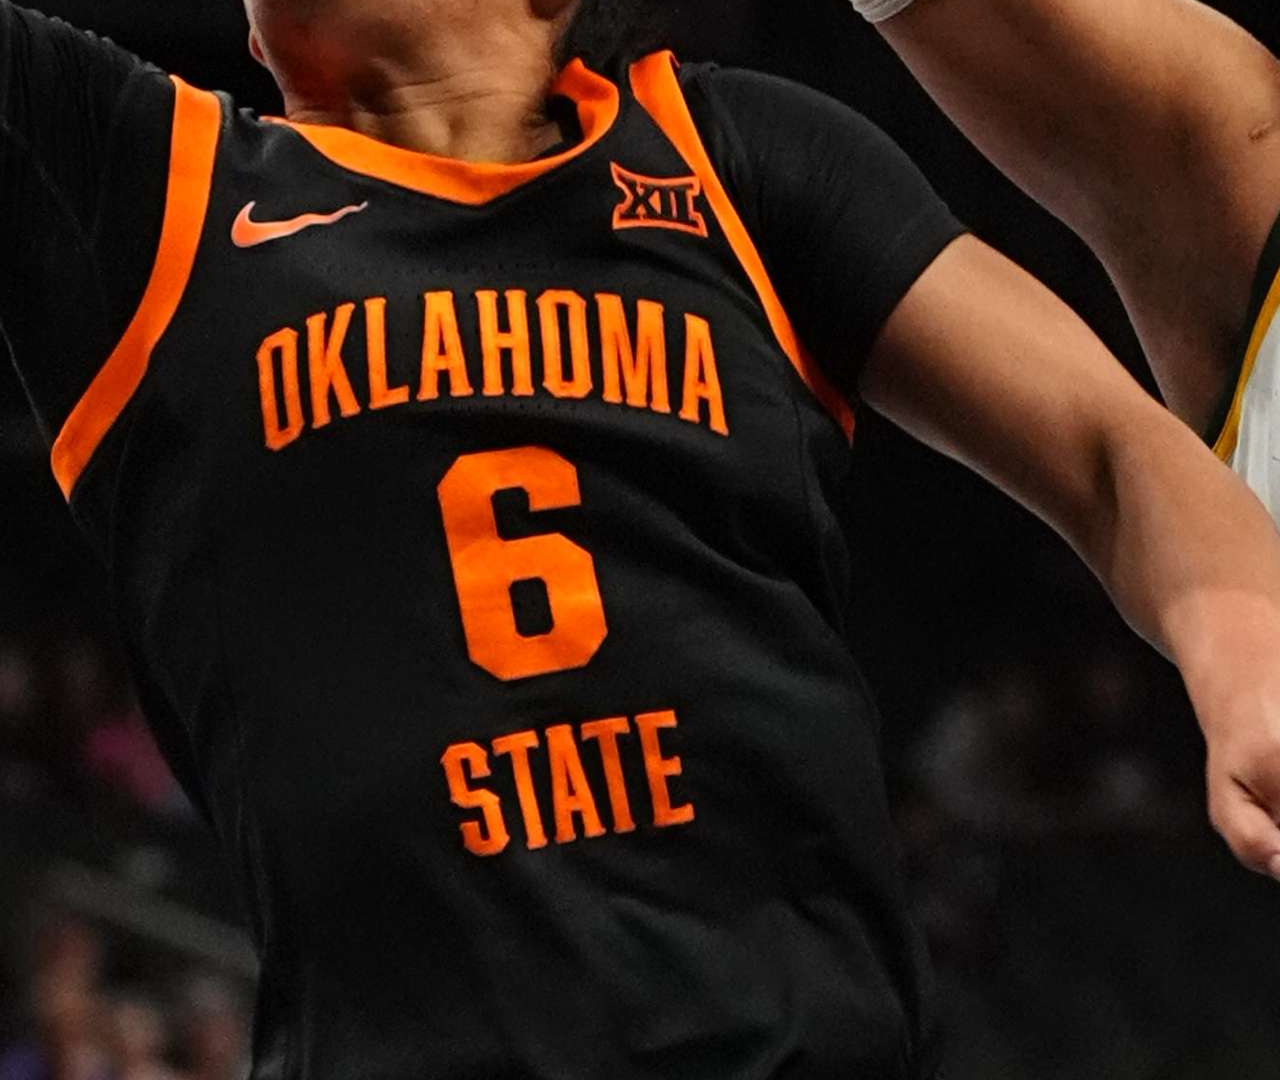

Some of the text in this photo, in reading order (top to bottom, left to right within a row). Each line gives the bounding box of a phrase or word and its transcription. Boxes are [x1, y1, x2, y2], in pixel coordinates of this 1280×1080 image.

[615, 169, 703, 230] XII
[255, 288, 729, 451] OKLAHOMA
[436, 445, 608, 681] 6
[440, 709, 695, 856] STATE
